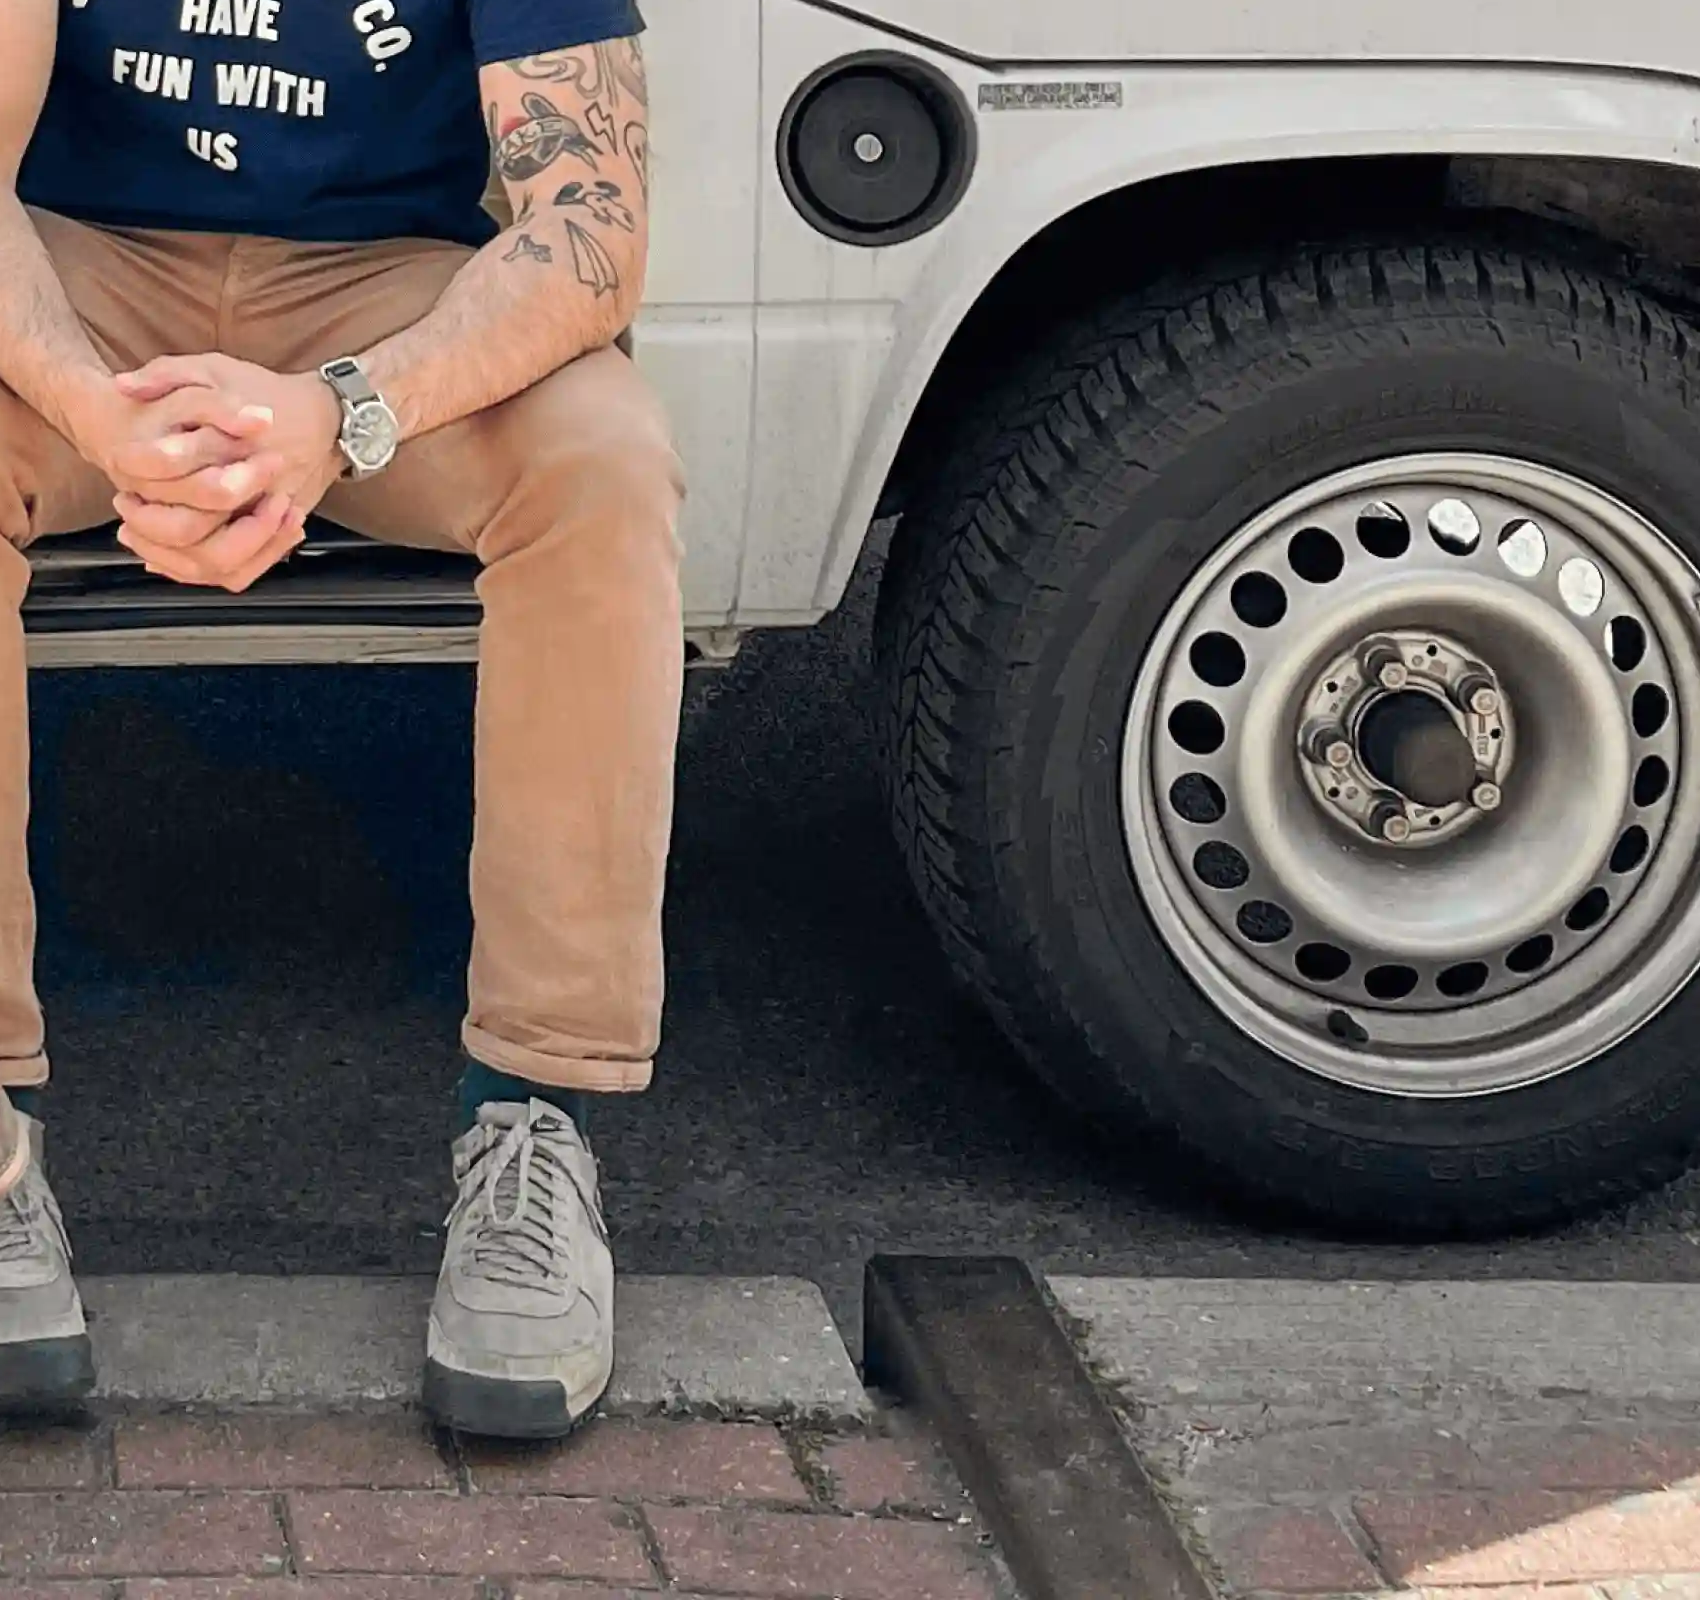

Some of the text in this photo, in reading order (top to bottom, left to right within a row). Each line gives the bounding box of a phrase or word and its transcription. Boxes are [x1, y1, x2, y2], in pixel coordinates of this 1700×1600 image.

[112, 48, 326, 117] FUN WITH
[187, 127, 239, 172] US
